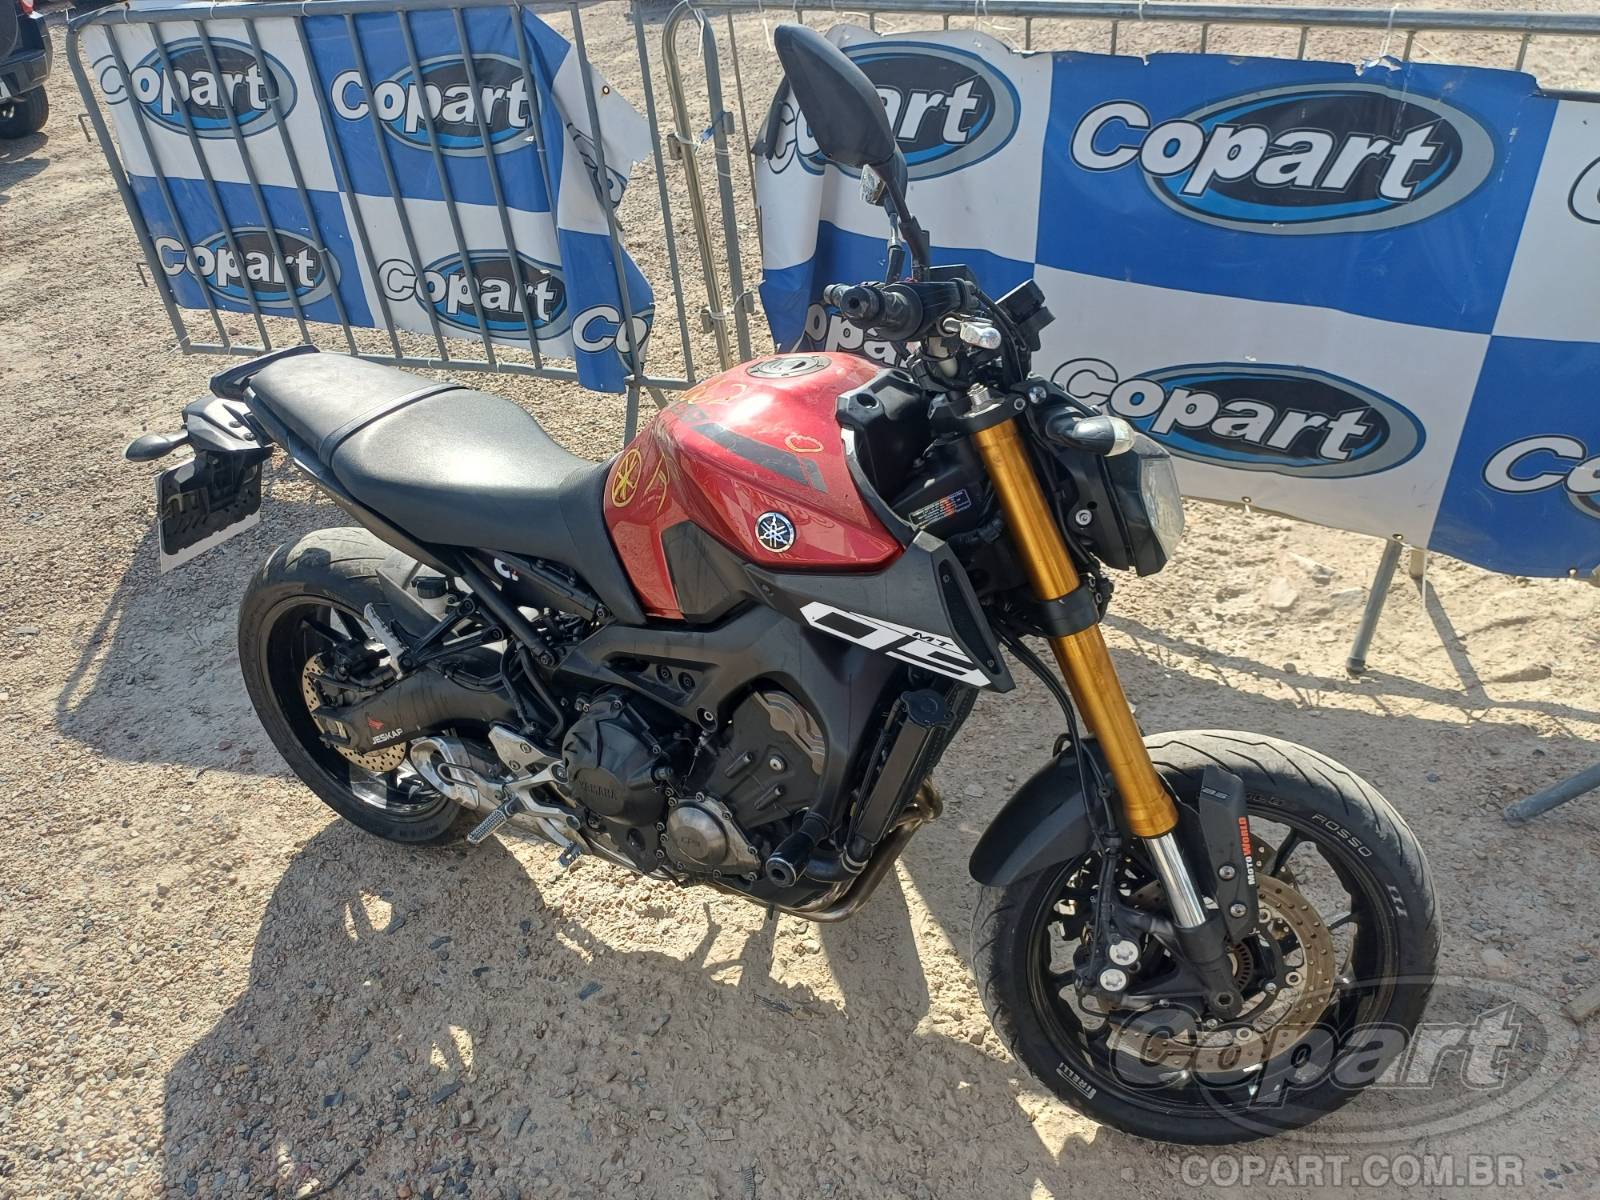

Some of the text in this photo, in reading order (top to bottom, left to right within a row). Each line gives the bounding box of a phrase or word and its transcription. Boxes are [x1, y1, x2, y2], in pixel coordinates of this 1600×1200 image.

[92, 54, 270, 115] Copart
[331, 70, 531, 134] Copart
[1071, 100, 1445, 204] Copart
[153, 237, 318, 288] Copart
[377, 259, 558, 323] Copart
[1050, 358, 1375, 464] Copart
[912, 631, 953, 648] MT
[1311, 813, 1373, 857] ROSSO
